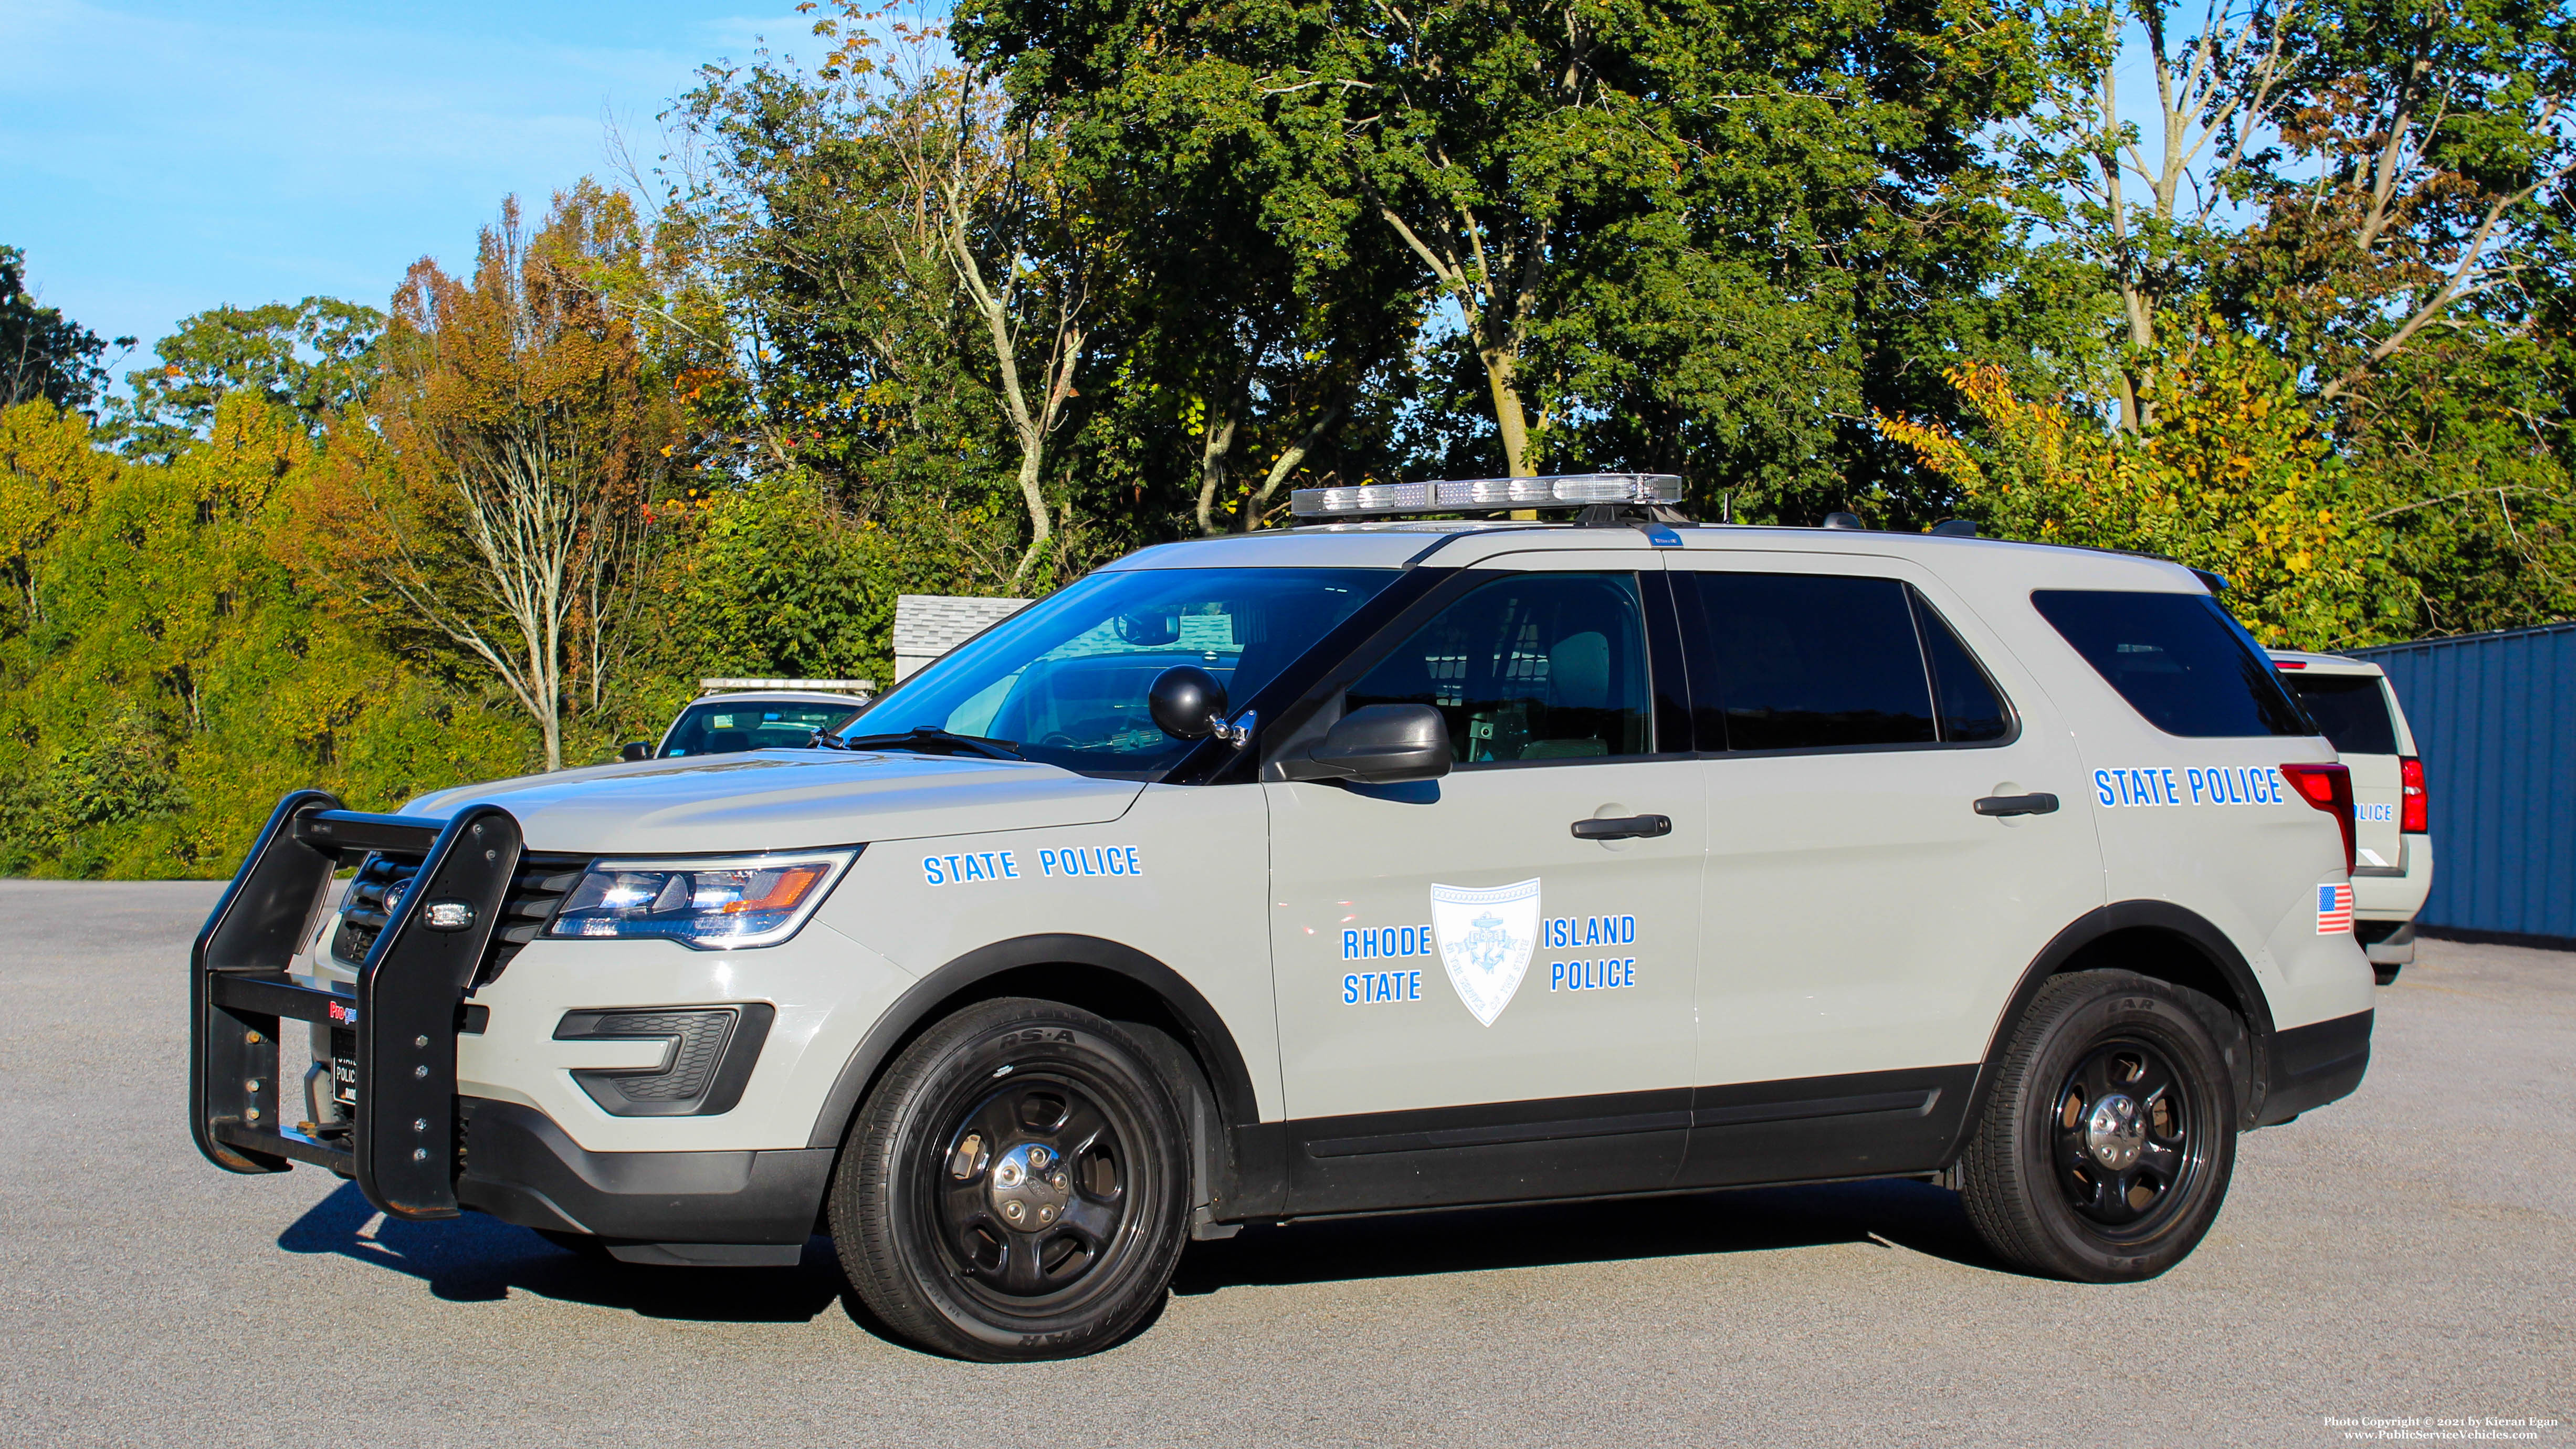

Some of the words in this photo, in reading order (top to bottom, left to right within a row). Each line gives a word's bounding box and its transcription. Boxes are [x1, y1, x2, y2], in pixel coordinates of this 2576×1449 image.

[2094, 768, 2181, 807] STATE
[2184, 766, 2283, 805] POLICE
[922, 851, 1019, 886] STATE
[1038, 846, 1142, 877] POLICE
[1342, 925, 1432, 960] RHODE
[1473, 932, 1499, 941] HOPE
[1544, 915, 1635, 949] ISLAND
[1450, 954, 1464, 977] THE
[1500, 973, 1516, 994] THE
[1512, 938, 1530, 972] STATE
[1551, 958, 1635, 991] POLICE
[1343, 971, 1421, 1005] STATE
[336, 1066, 355, 1084] POLIC
